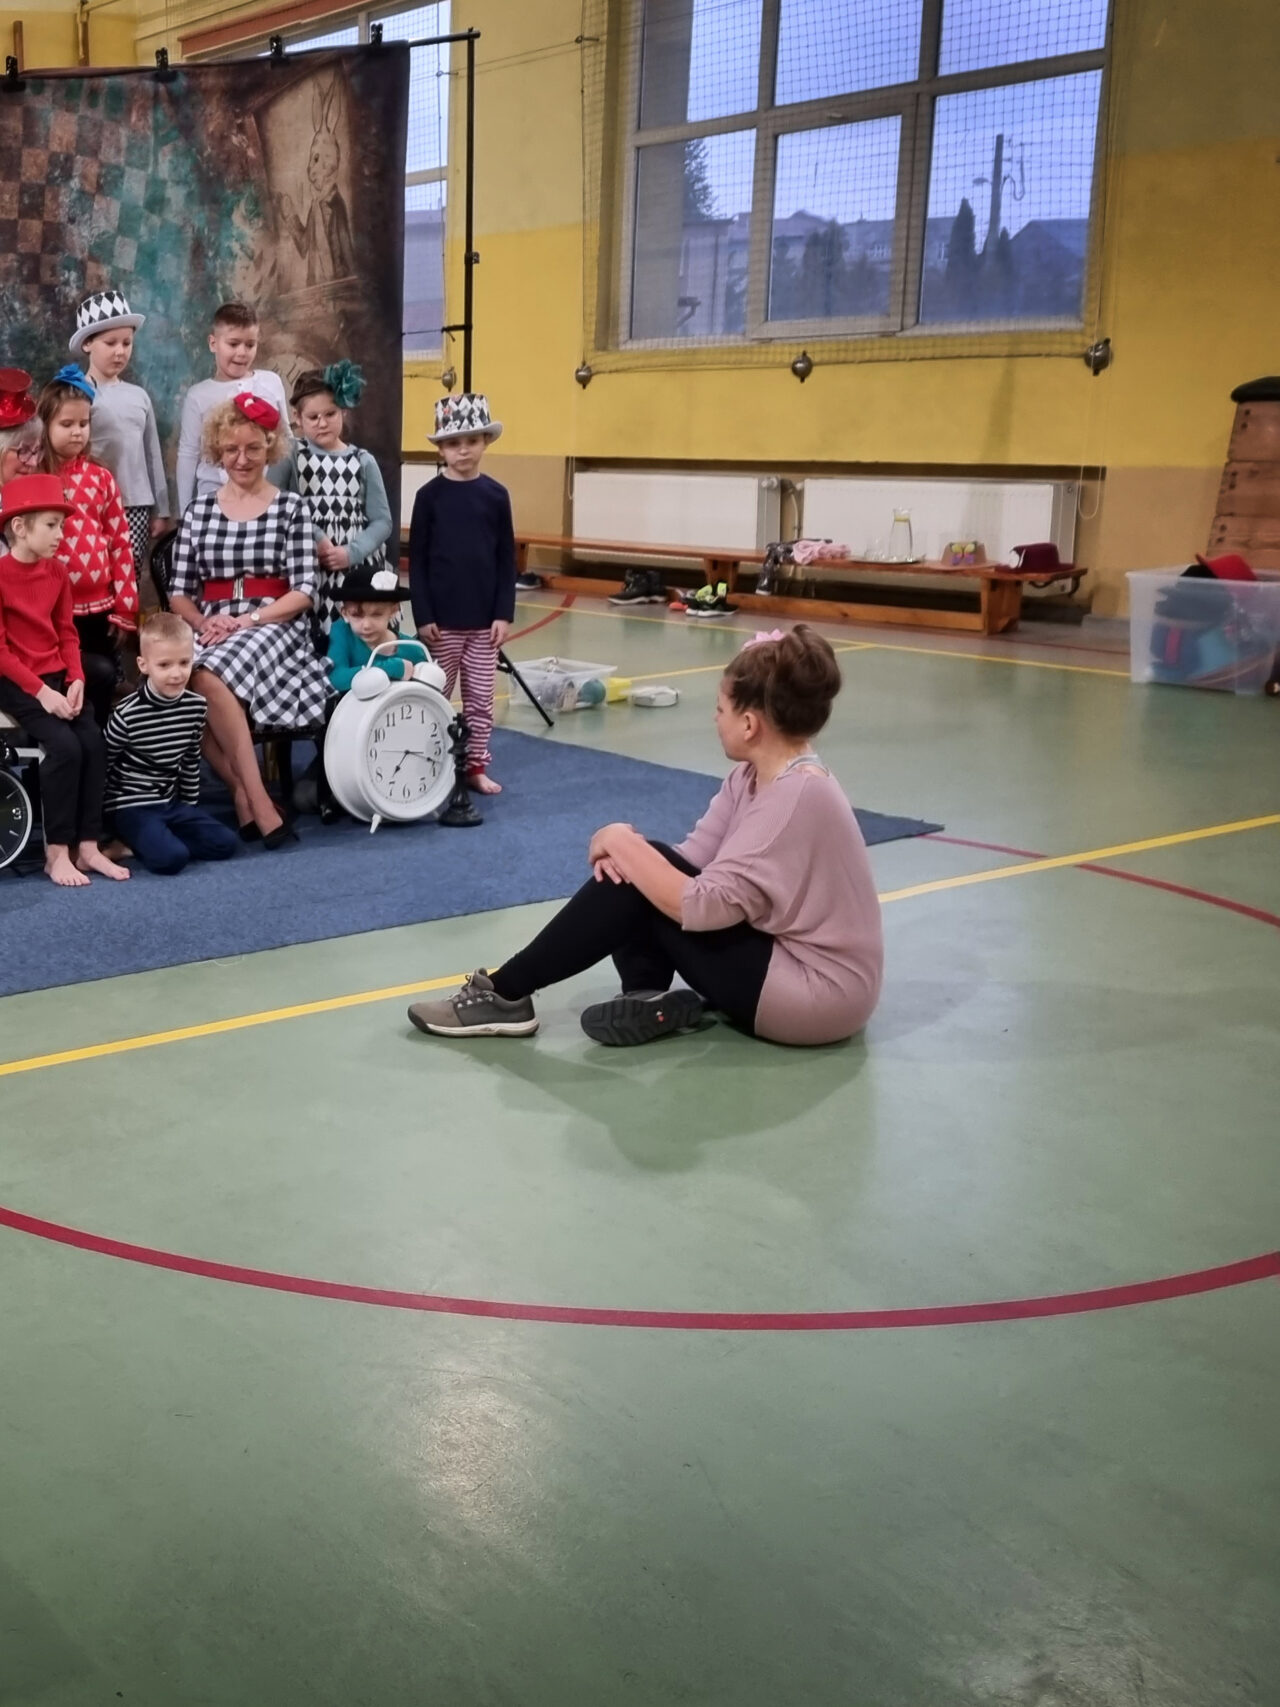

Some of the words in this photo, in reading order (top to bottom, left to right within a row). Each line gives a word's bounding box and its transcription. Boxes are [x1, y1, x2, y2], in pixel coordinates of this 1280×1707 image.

[386, 711, 396, 727] 11
[400, 704, 412, 720] 12
[421, 709, 425, 724] 1
[374, 728, 386, 743] 10
[430, 722, 438, 737] 2
[369, 748, 377, 761] 9
[434, 740, 442, 756] 3
[375, 766, 383, 782] 8
[388, 781, 395, 797] 7
[402, 784, 410, 799] 6
[419, 777, 427, 792] 5
[12, 807, 22, 820] 3
